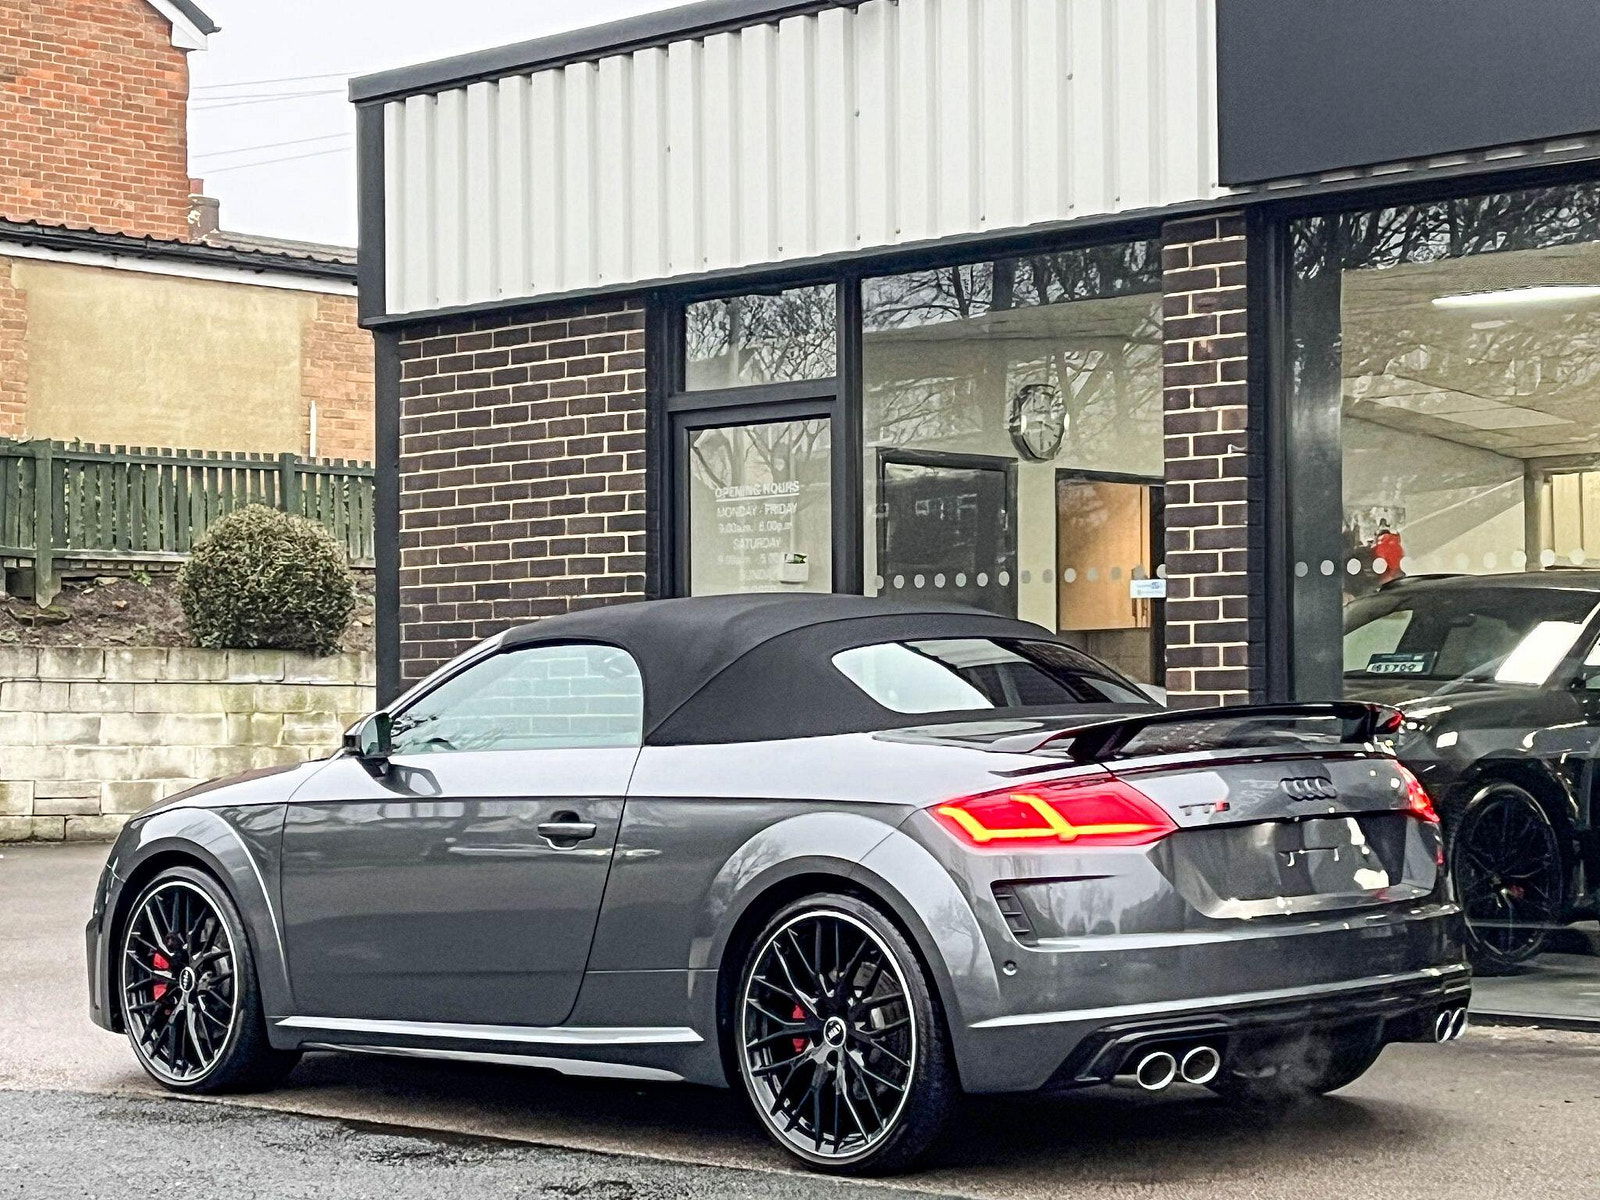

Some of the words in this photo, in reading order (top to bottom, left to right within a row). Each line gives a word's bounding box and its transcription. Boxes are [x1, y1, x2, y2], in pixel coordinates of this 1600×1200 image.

[715, 484, 761, 498] OPENING
[763, 480, 800, 494] HOURS
[716, 505, 757, 518] MONDAY
[764, 502, 798, 515] FRIDAY
[733, 537, 781, 550] SATURDAY
